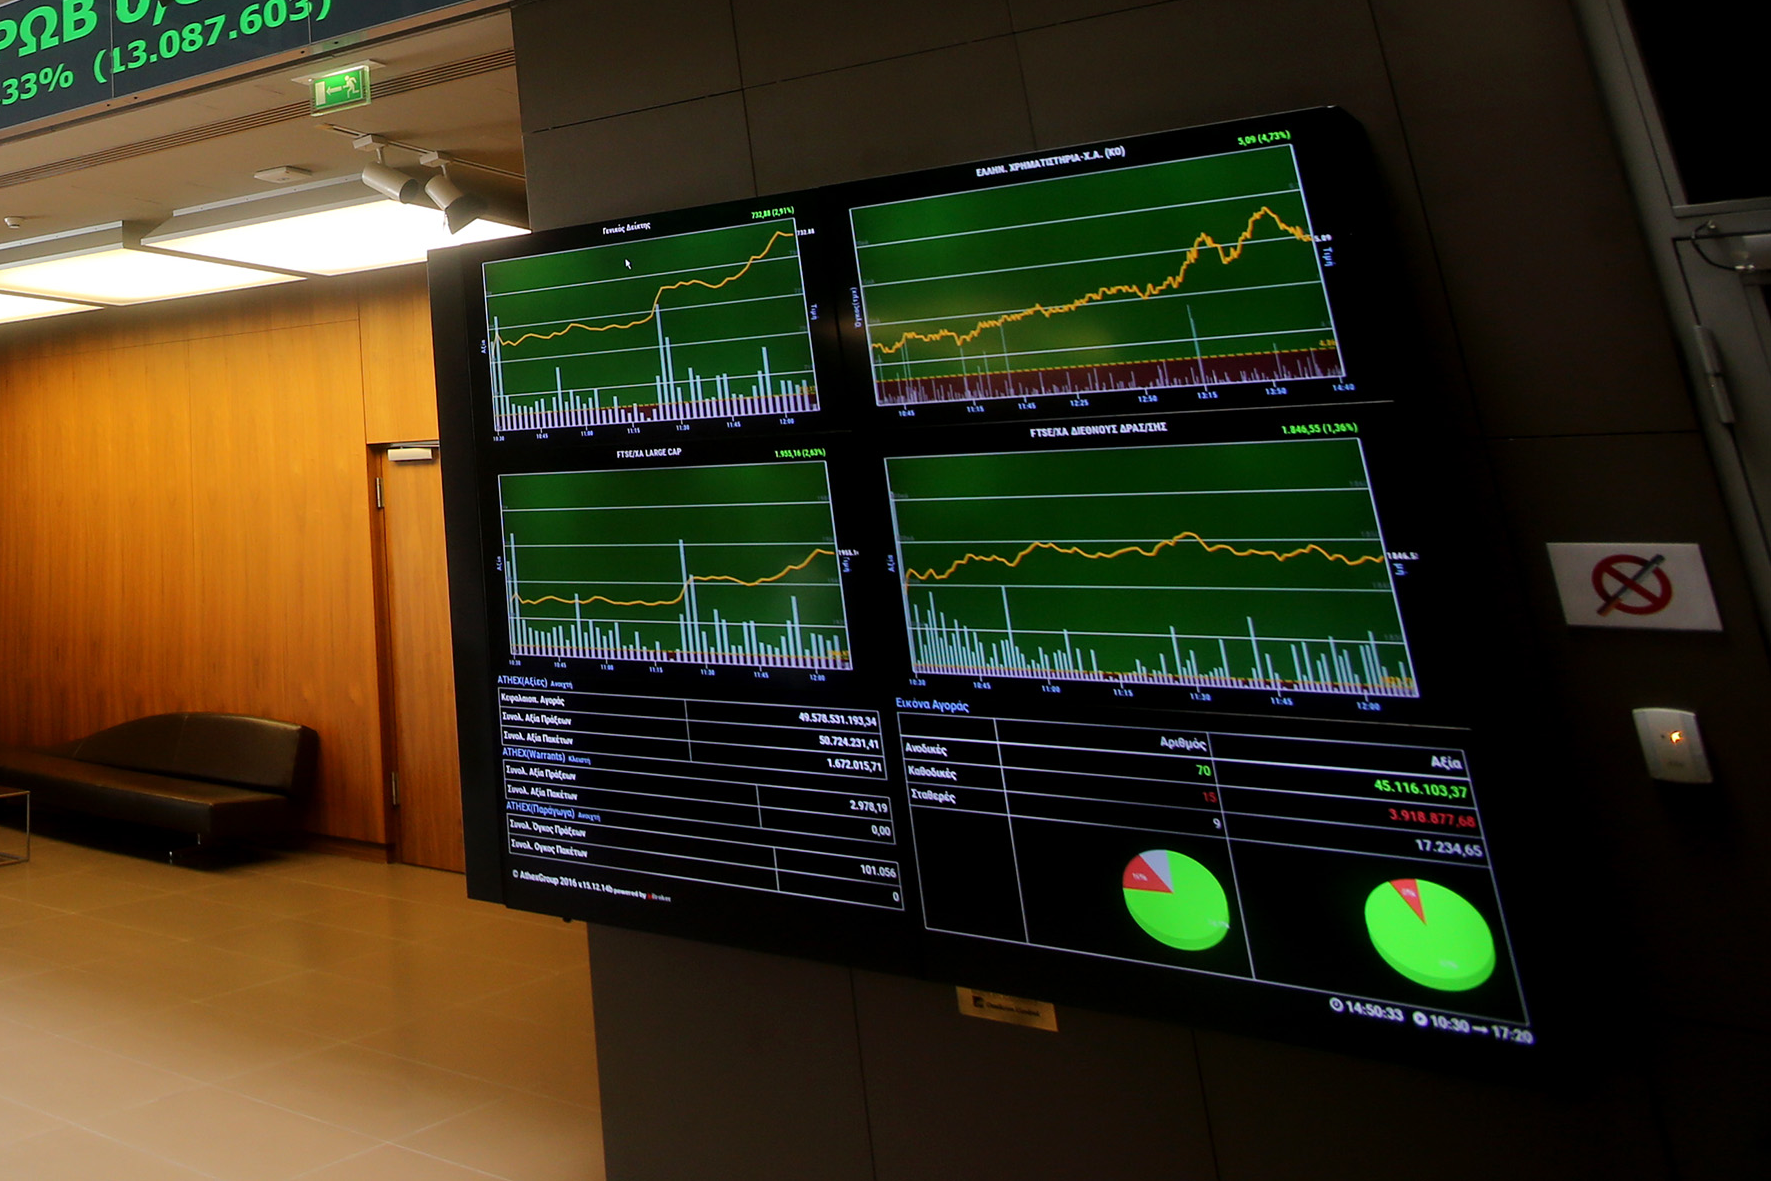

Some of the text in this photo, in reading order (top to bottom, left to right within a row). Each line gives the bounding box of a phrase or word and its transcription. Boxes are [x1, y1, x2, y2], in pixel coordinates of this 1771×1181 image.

[645, 449, 667, 457] LARGE
[667, 447, 682, 456] CAP
[895, 697, 969, 713] Εικόνα Αγοράς
[905, 741, 948, 757] Ανοδικές
[1160, 735, 1207, 752] Αριθμός
[827, 758, 882, 773] 1.672.015,71
[1196, 764, 1211, 776] 70
[1430, 754, 1463, 771] Αξία
[908, 765, 957, 781] Καθοδικές
[911, 788, 957, 804] Σταθερές
[1374, 778, 1468, 799] 45.116.103,37
[1202, 791, 1217, 803] 15
[849, 799, 888, 814] 2.978,19
[1212, 817, 1221, 830] 9
[1389, 807, 1477, 828] 3.918.877,68
[871, 825, 891, 837] 0,00
[1415, 838, 1483, 858] 17.234,65
[860, 864, 897, 878] 101.056
[560, 876, 578, 888] 2016
[892, 892, 899, 902] 0
[1345, 1000, 1534, 1045] 14:50:33 10:30 17:20
